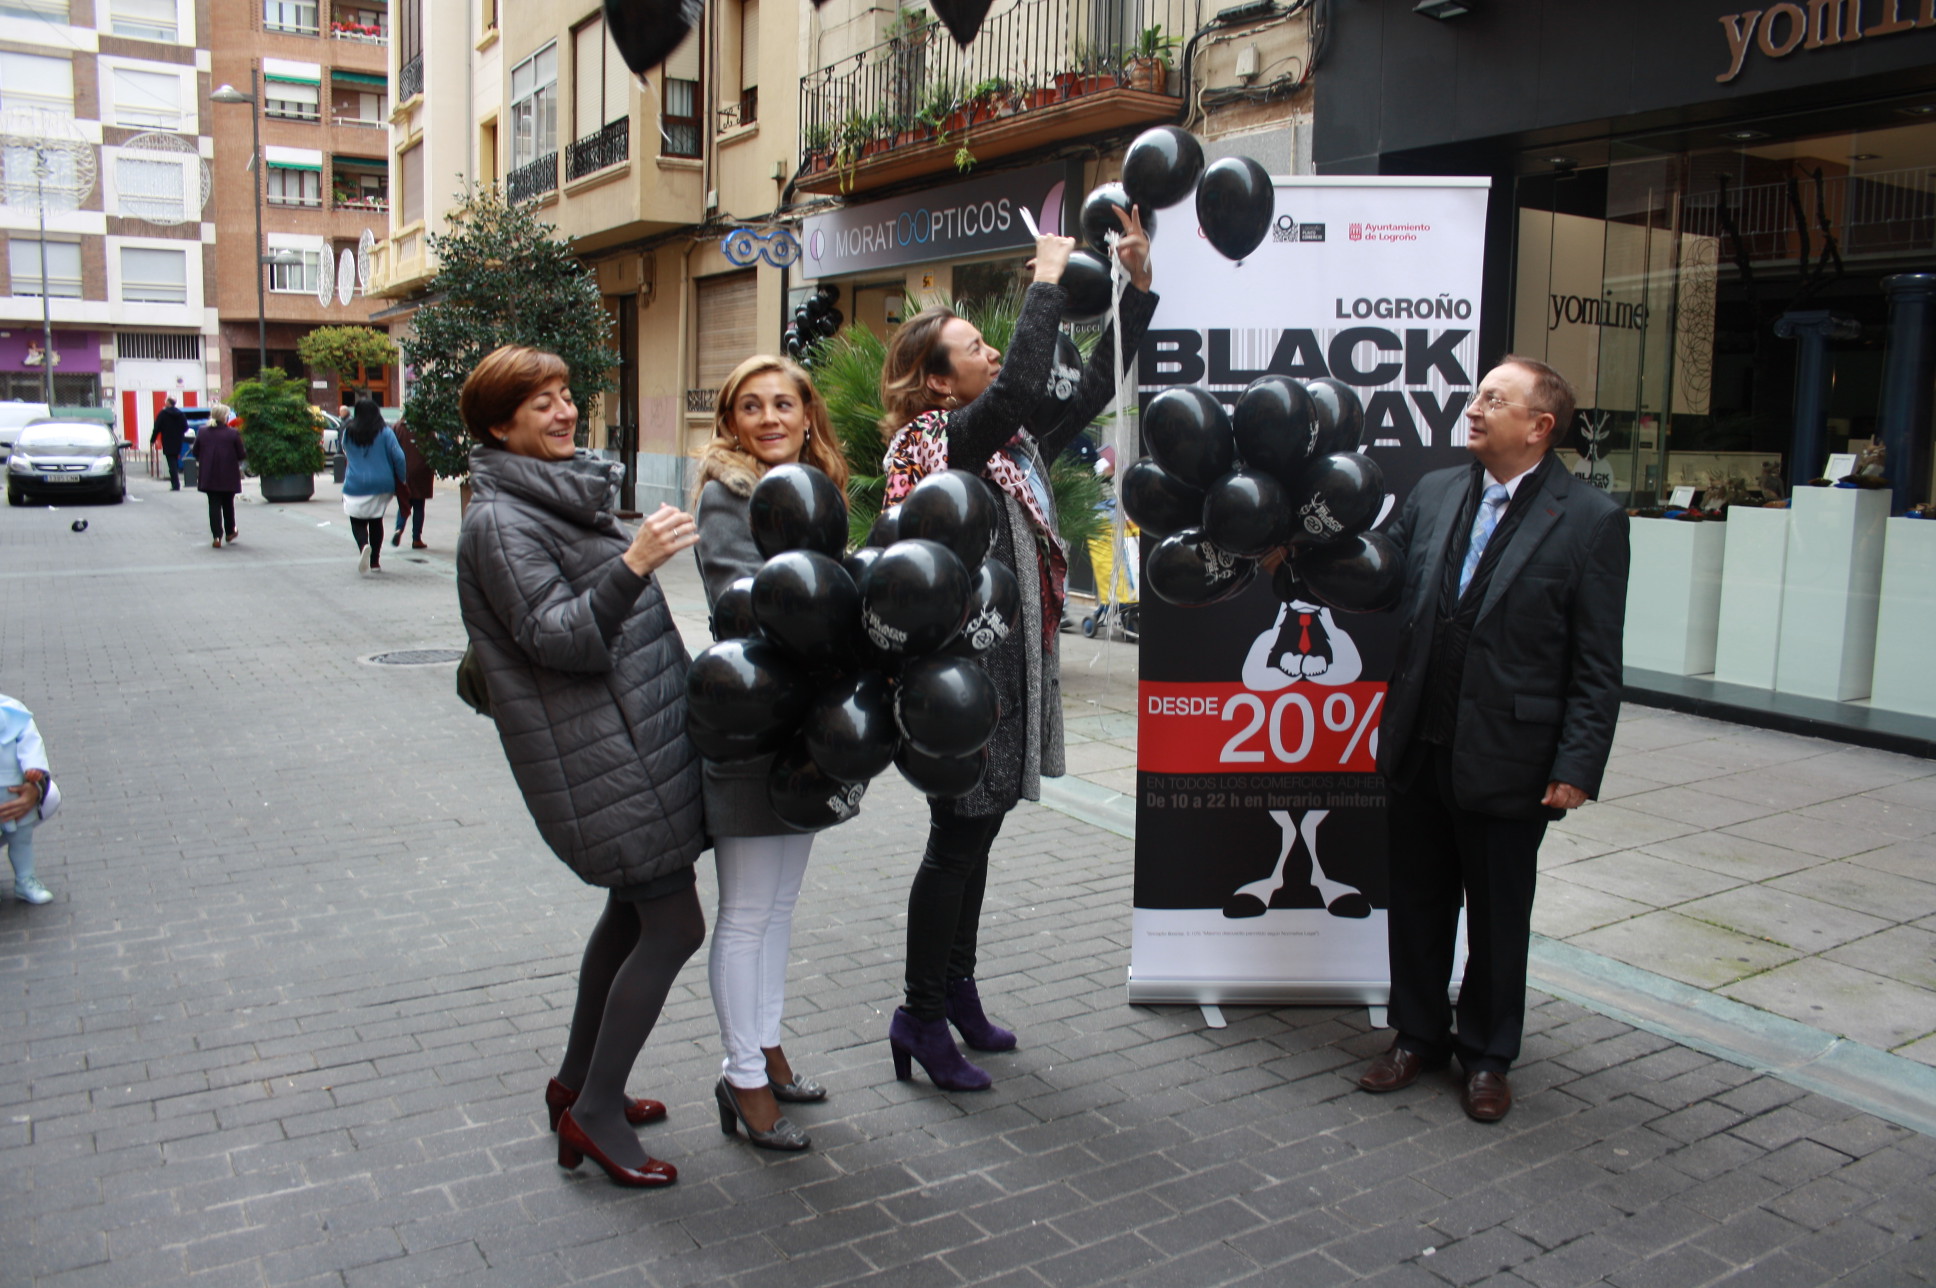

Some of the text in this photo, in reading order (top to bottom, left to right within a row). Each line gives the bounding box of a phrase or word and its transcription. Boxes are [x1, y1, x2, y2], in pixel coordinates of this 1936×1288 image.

[1365, 223, 1430, 232] Ayuntamiento
[1365, 233, 1417, 243] de Logroño
[1336, 293, 1472, 320] LOGROÑO
[1549, 289, 1649, 331] yomime
[1075, 324, 1100, 333] GUCCI
[1138, 327, 1472, 387] BLACK
[1318, 504, 1344, 530] BLACK
[1148, 692, 1384, 765] DESDE 20%
[1147, 775, 1385, 790] EN TODOS LOS COMERCIOS ADHER
[1147, 793, 1165, 808] De
[1171, 793, 1188, 808] 10
[1193, 796, 1202, 808] a
[1207, 793, 1225, 808] 22
[1231, 793, 1240, 807] h
[1244, 796, 1263, 807] en
[1268, 792, 1322, 808] horario
